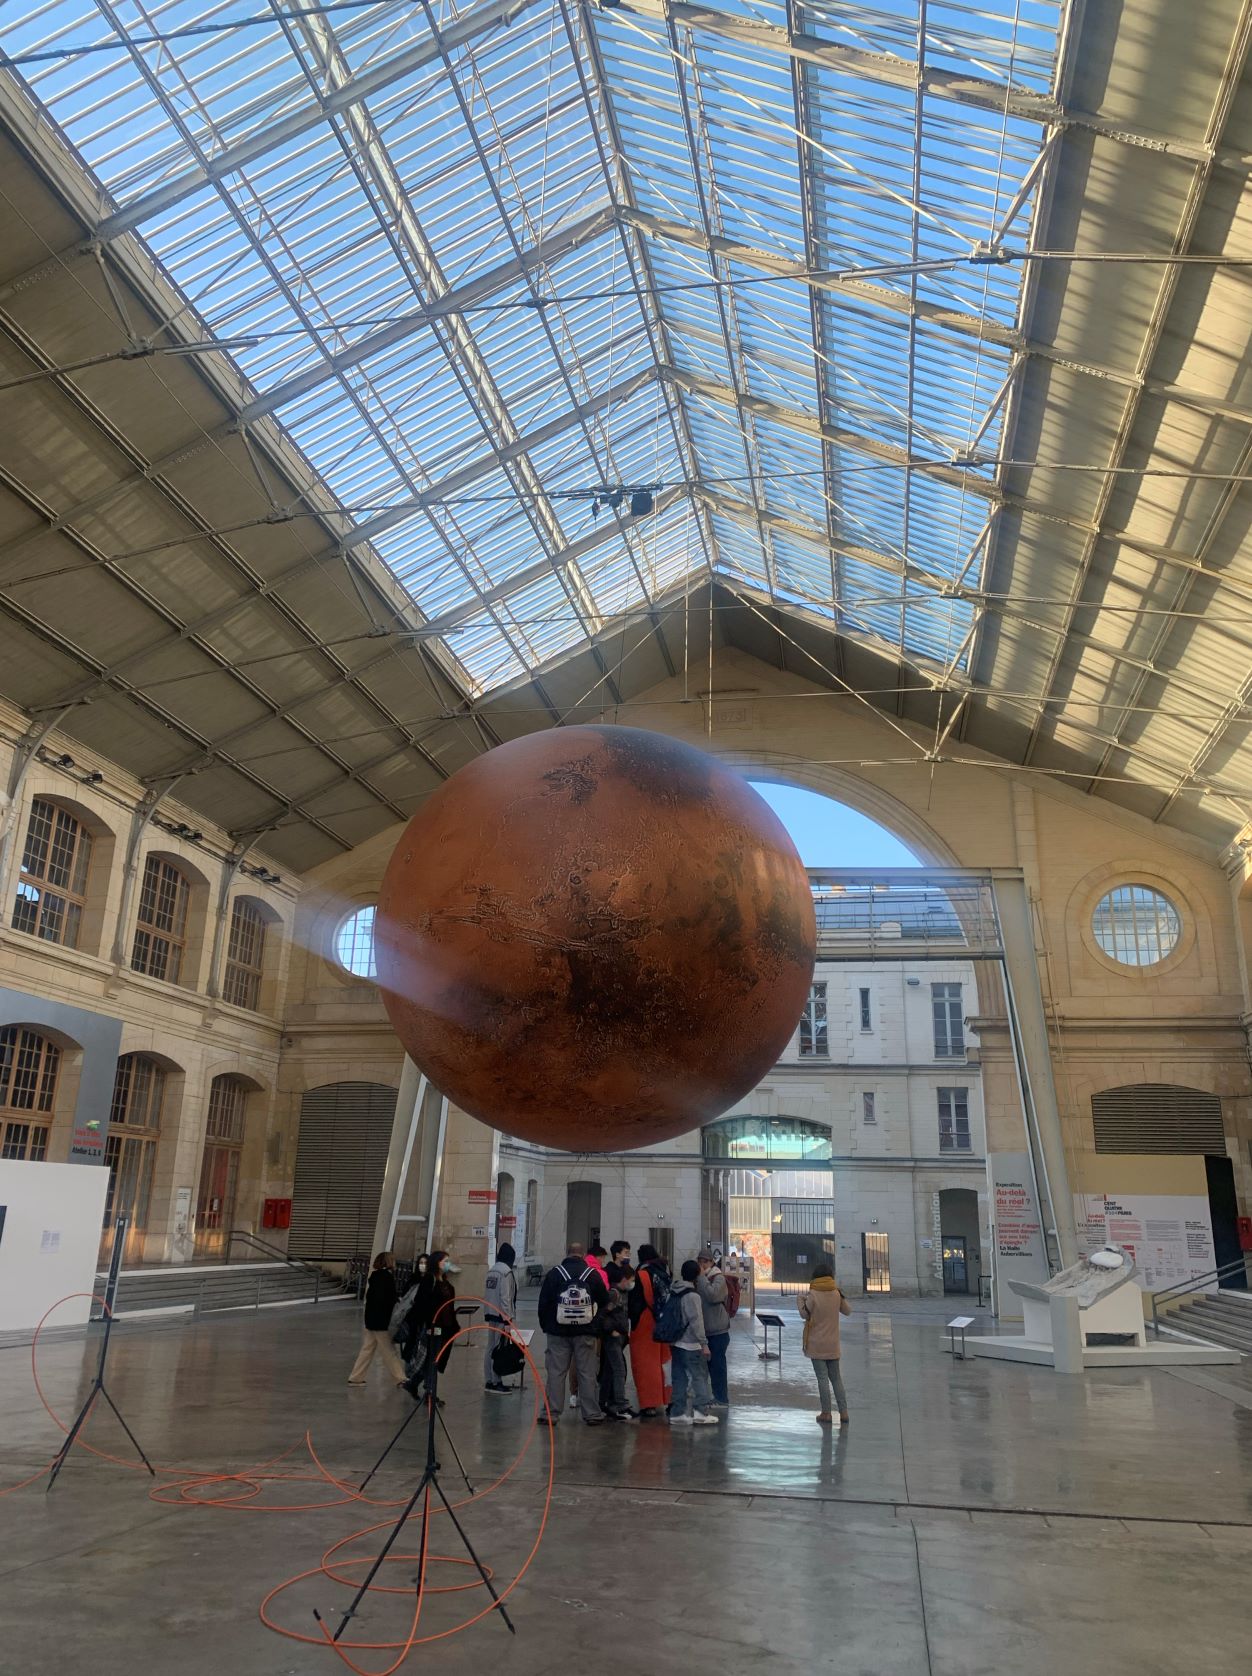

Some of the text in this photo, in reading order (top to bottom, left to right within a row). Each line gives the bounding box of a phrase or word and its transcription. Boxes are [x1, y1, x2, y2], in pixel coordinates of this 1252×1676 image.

[997, 1189, 1026, 1197] Au-delà
[1009, 1197, 1025, 1205] réel
[932, 1192, 944, 1280] Administration
